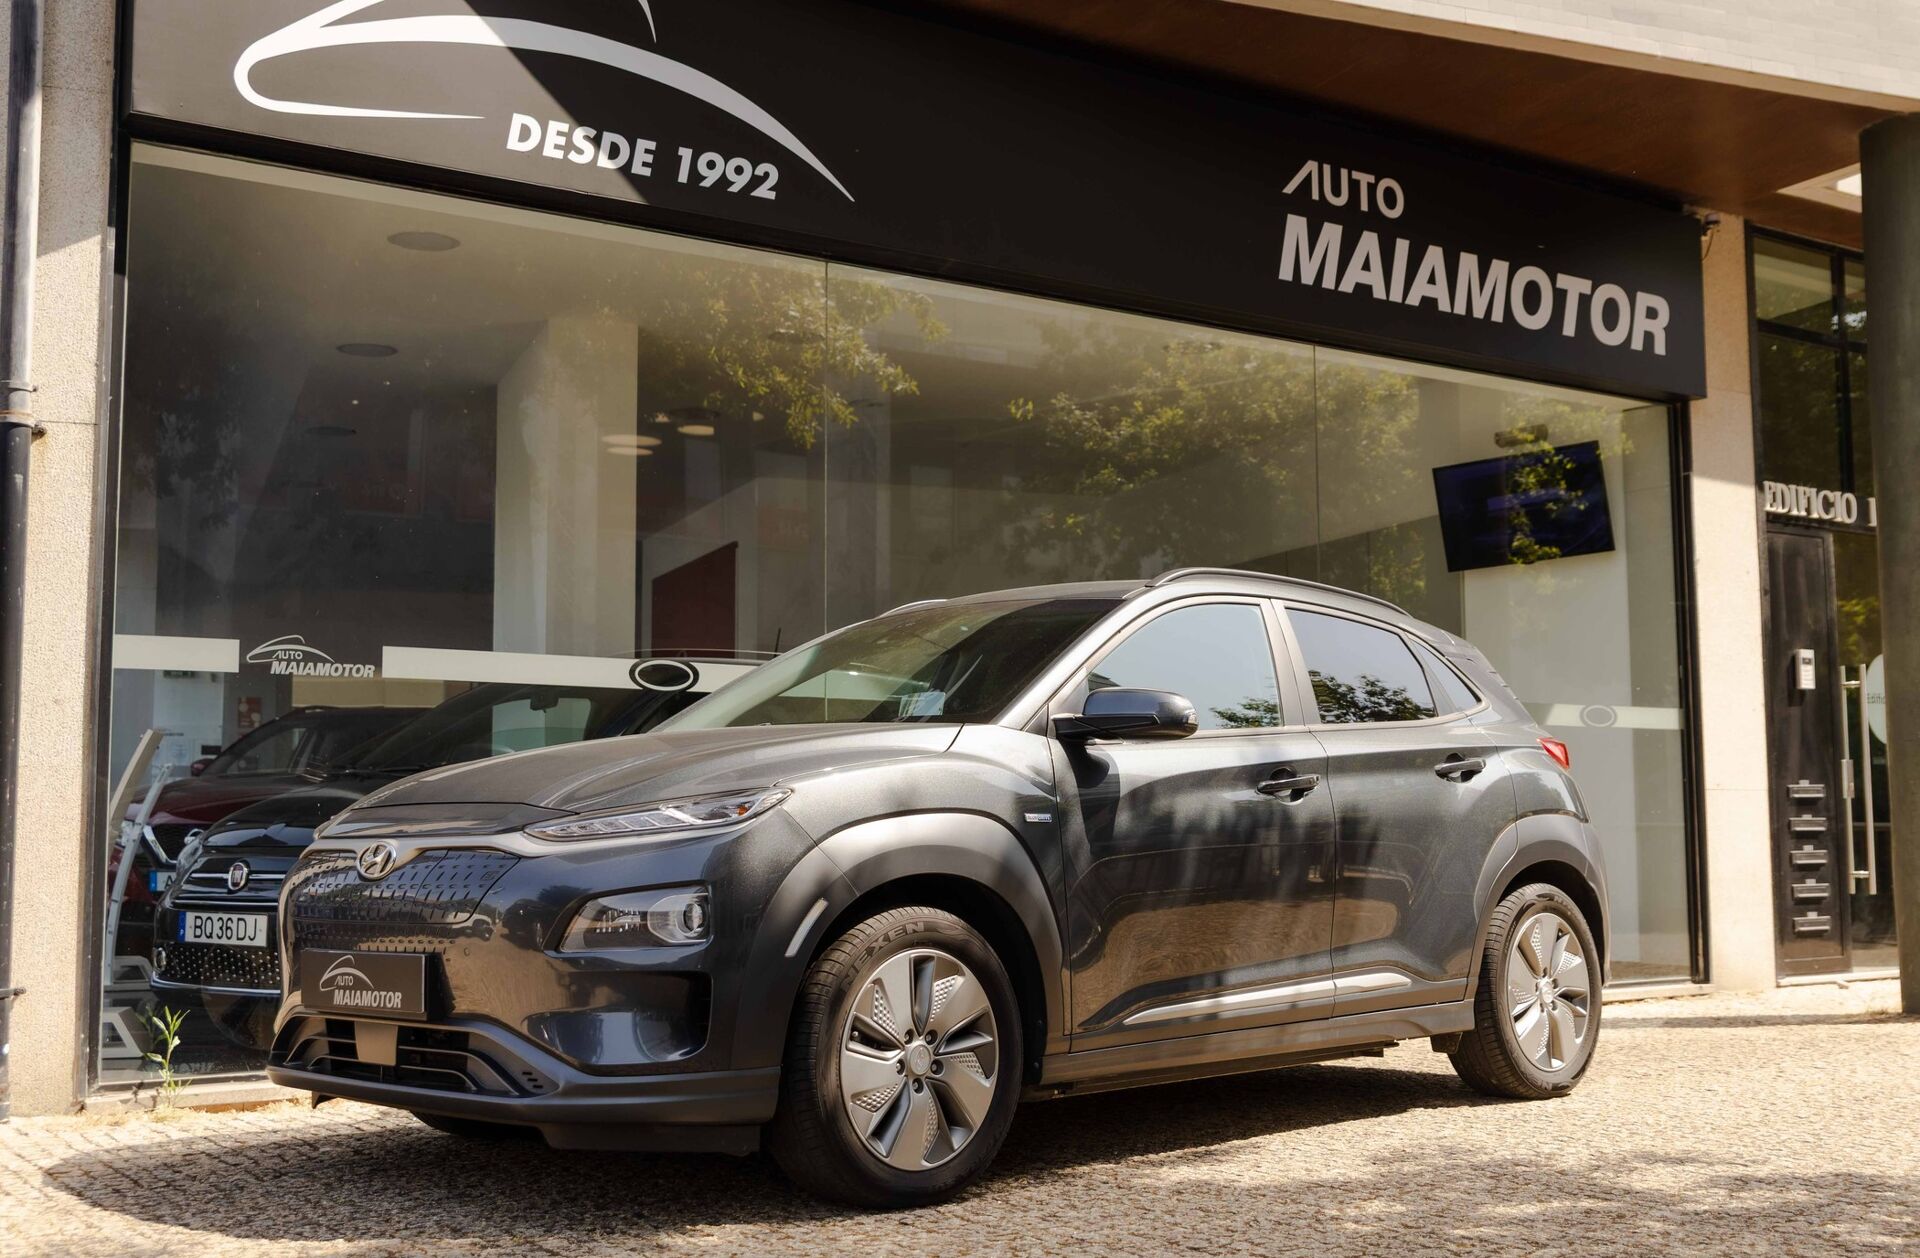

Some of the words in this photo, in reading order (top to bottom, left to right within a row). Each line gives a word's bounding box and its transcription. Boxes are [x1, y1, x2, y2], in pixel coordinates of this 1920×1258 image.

[506, 112, 657, 177] DESDE
[677, 146, 779, 200] 1992
[1282, 159, 1404, 219] AUTO
[1278, 213, 1670, 356] MAIAMOTOR
[272, 650, 303, 660] AUTO
[270, 660, 375, 678] MAIAMOTOR
[334, 975, 354, 986] AUTO
[333, 989, 402, 1009] MAIAMOTOR
